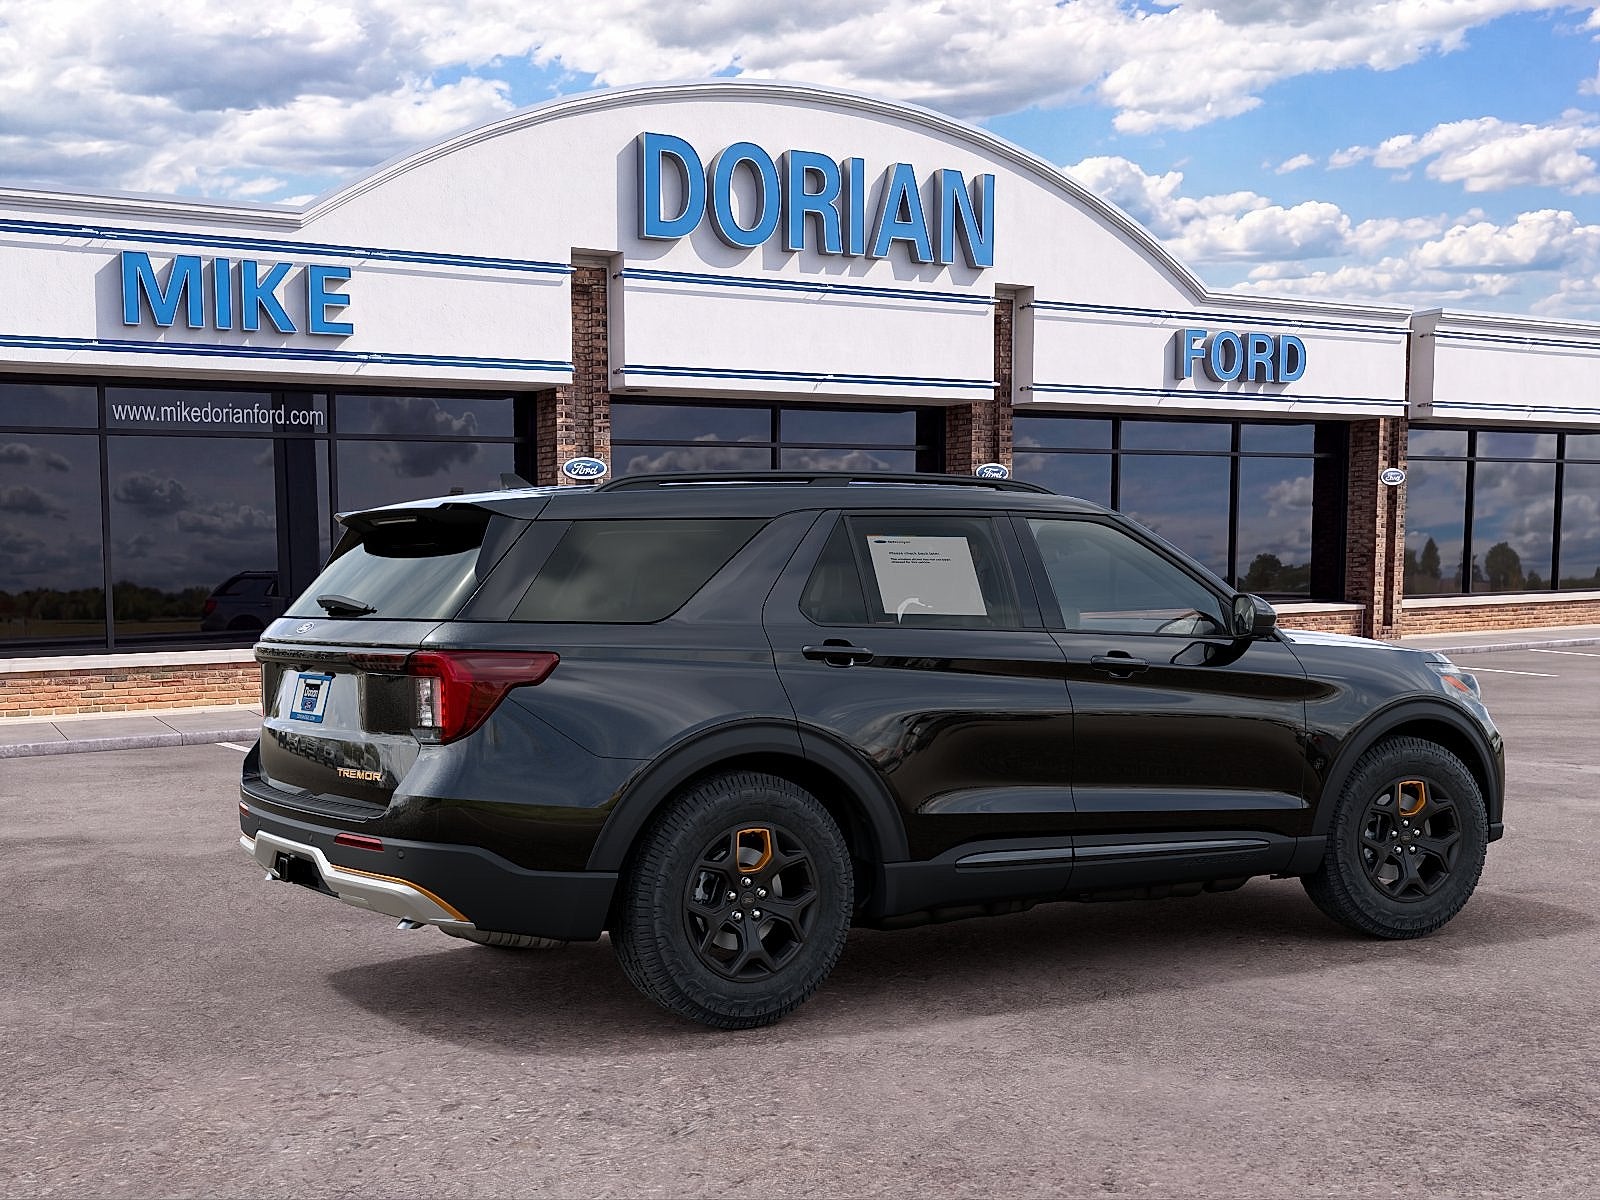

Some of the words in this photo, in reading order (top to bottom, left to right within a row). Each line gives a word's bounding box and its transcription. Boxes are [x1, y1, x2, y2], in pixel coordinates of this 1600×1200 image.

[638, 132, 995, 268] DORIAN
[121, 250, 354, 336] MIKE
[1176, 328, 1307, 383] FORD
[111, 401, 324, 426] www.mikedorianford.com
[337, 767, 382, 782] TREMOR
